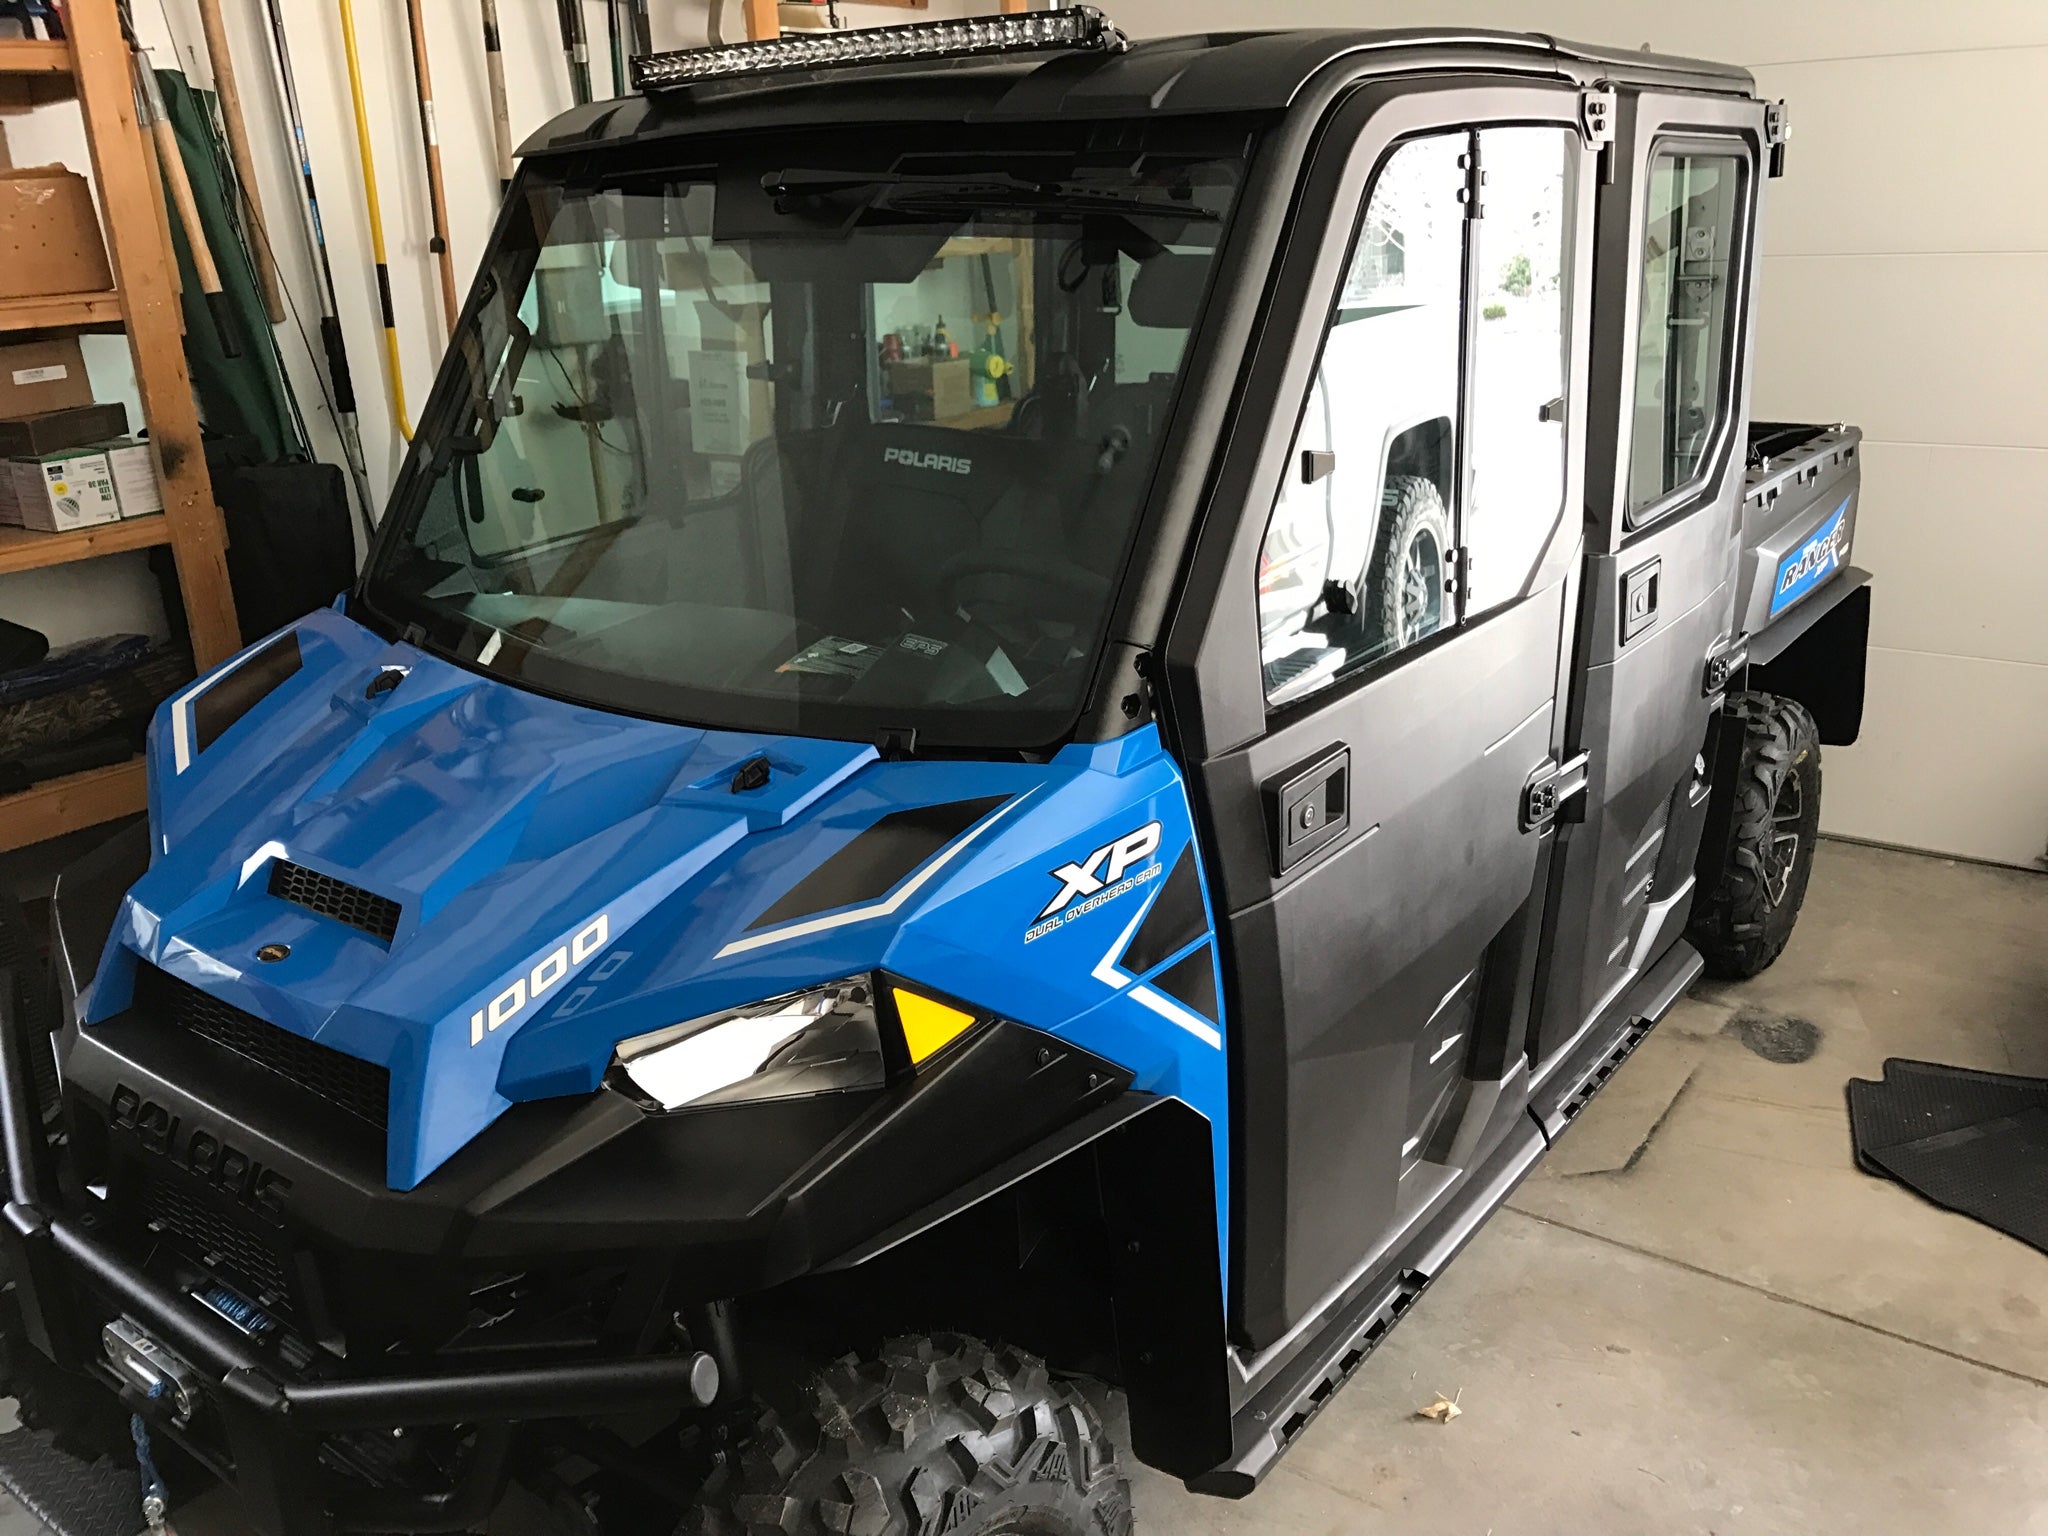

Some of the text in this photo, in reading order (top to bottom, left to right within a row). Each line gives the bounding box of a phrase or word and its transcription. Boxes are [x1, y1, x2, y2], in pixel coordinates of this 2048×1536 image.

[884, 447, 972, 474] POLARIS
[1024, 863, 1162, 943] DUAL OVERHEAD CAM
[1029, 820, 1162, 927] XP
[470, 913, 608, 1048] 1000
[110, 1083, 293, 1229] POLARIS
